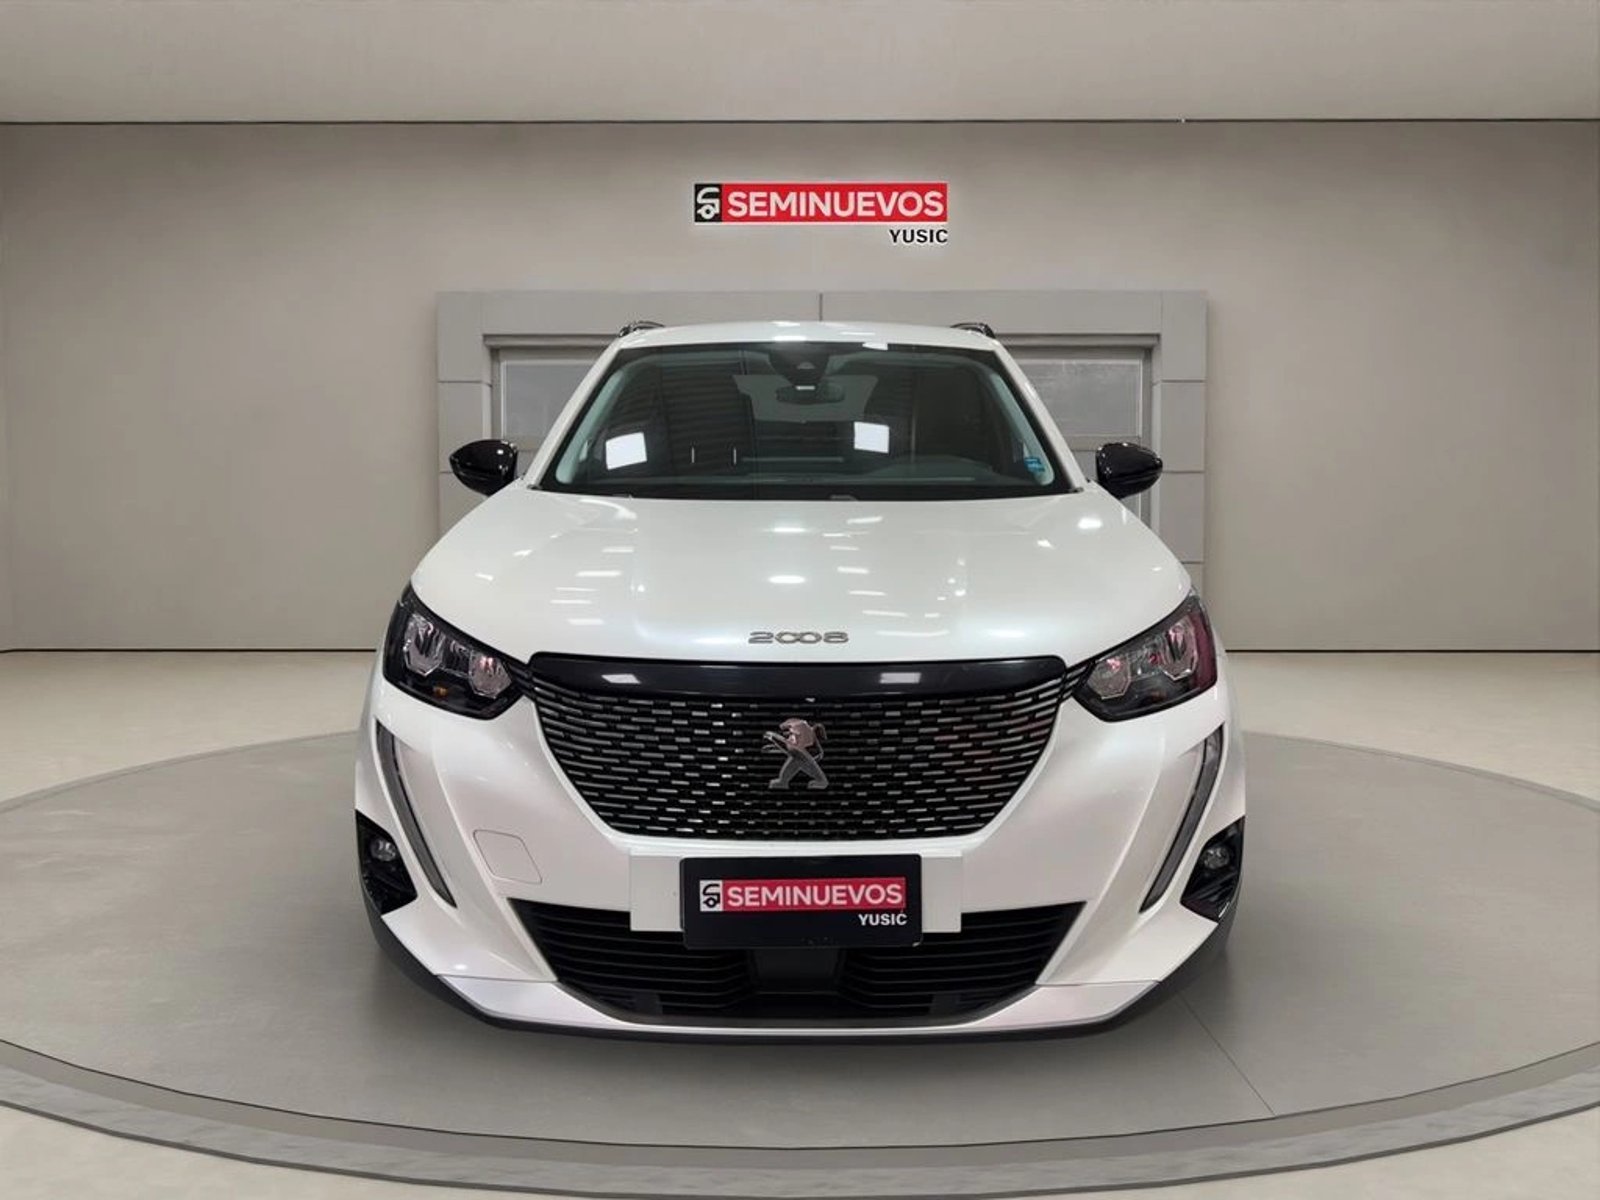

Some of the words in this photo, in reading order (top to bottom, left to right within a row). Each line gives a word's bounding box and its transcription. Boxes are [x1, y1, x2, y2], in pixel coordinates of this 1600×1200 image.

[727, 190, 945, 218] SEMINUEVOS
[889, 229, 948, 243] YUSIC
[748, 631, 849, 644] 2008
[727, 884, 903, 907] SEMINUEVOS
[858, 913, 908, 926] YUSIC
